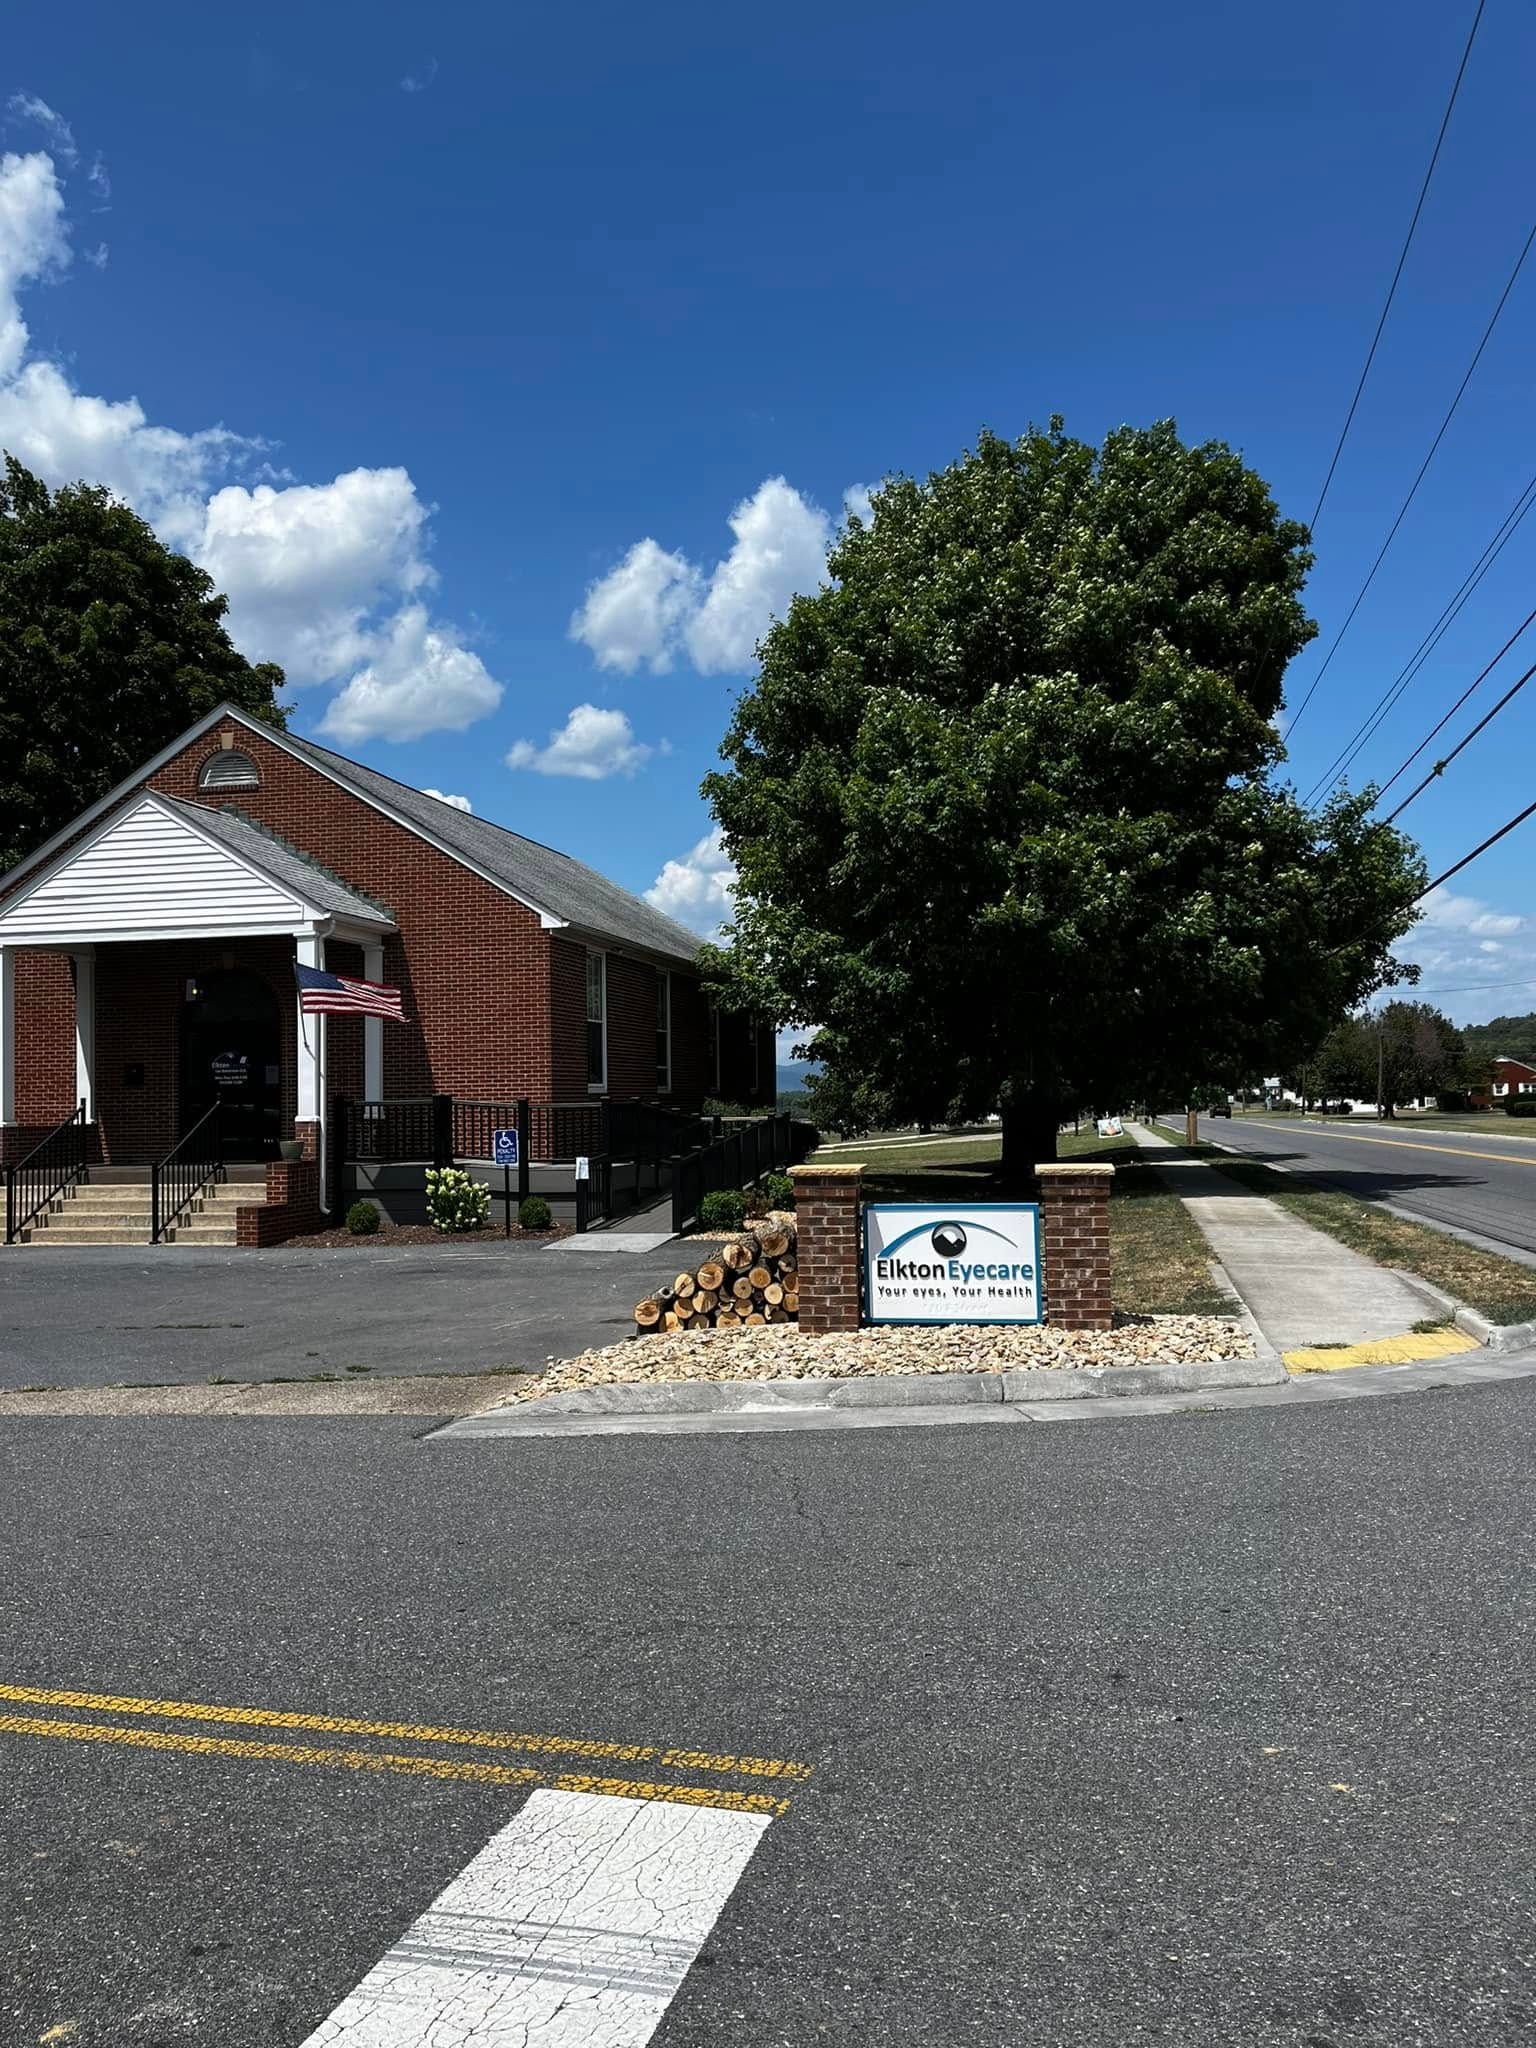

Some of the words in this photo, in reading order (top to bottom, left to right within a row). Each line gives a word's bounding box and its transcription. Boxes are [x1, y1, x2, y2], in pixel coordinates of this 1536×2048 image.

[877, 1259, 945, 1280] Elkton
[948, 1260, 1033, 1285] Eyecare
[878, 1286, 907, 1298] Your
[913, 1288, 946, 1299] eyes,
[953, 1286, 982, 1297] Your
[988, 1286, 1032, 1297] Health
